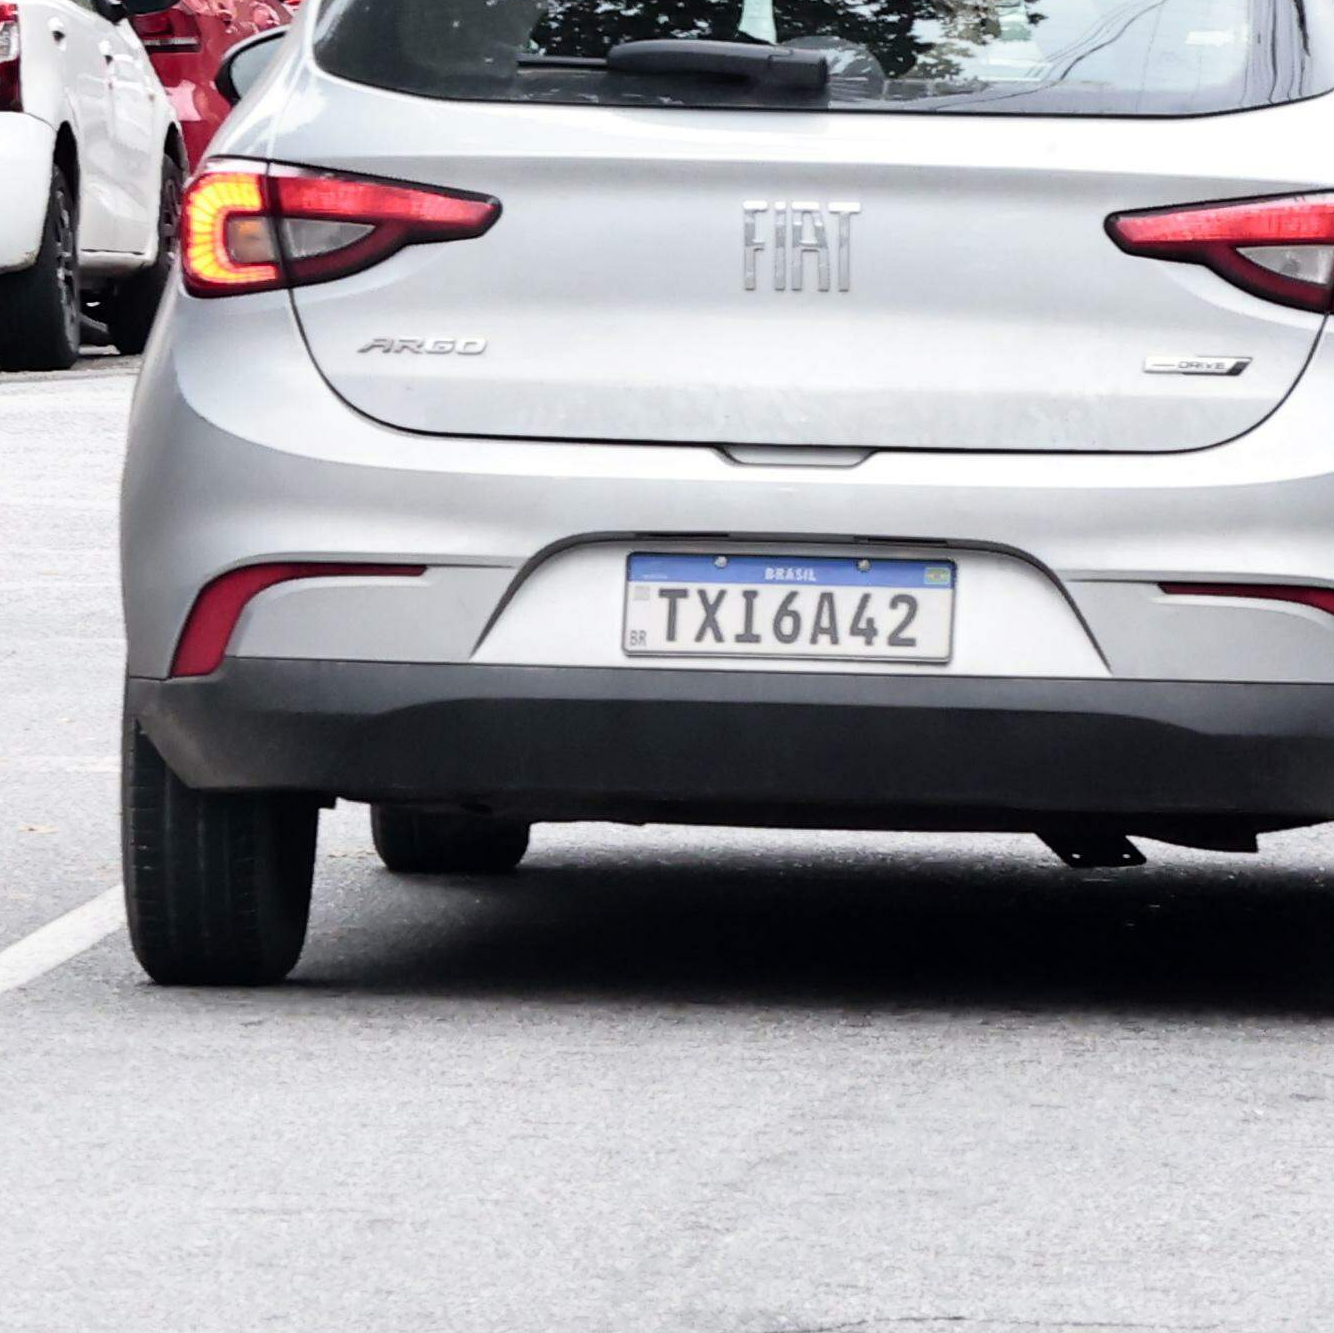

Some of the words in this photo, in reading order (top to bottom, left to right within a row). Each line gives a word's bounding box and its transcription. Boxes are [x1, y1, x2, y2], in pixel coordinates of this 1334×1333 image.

[742, 200, 862, 293] FIAT
[357, 336, 488, 356] ARGO
[764, 567, 817, 582] BRASIL
[657, 588, 919, 648] TXI6A42
[629, 629, 648, 647] BR
